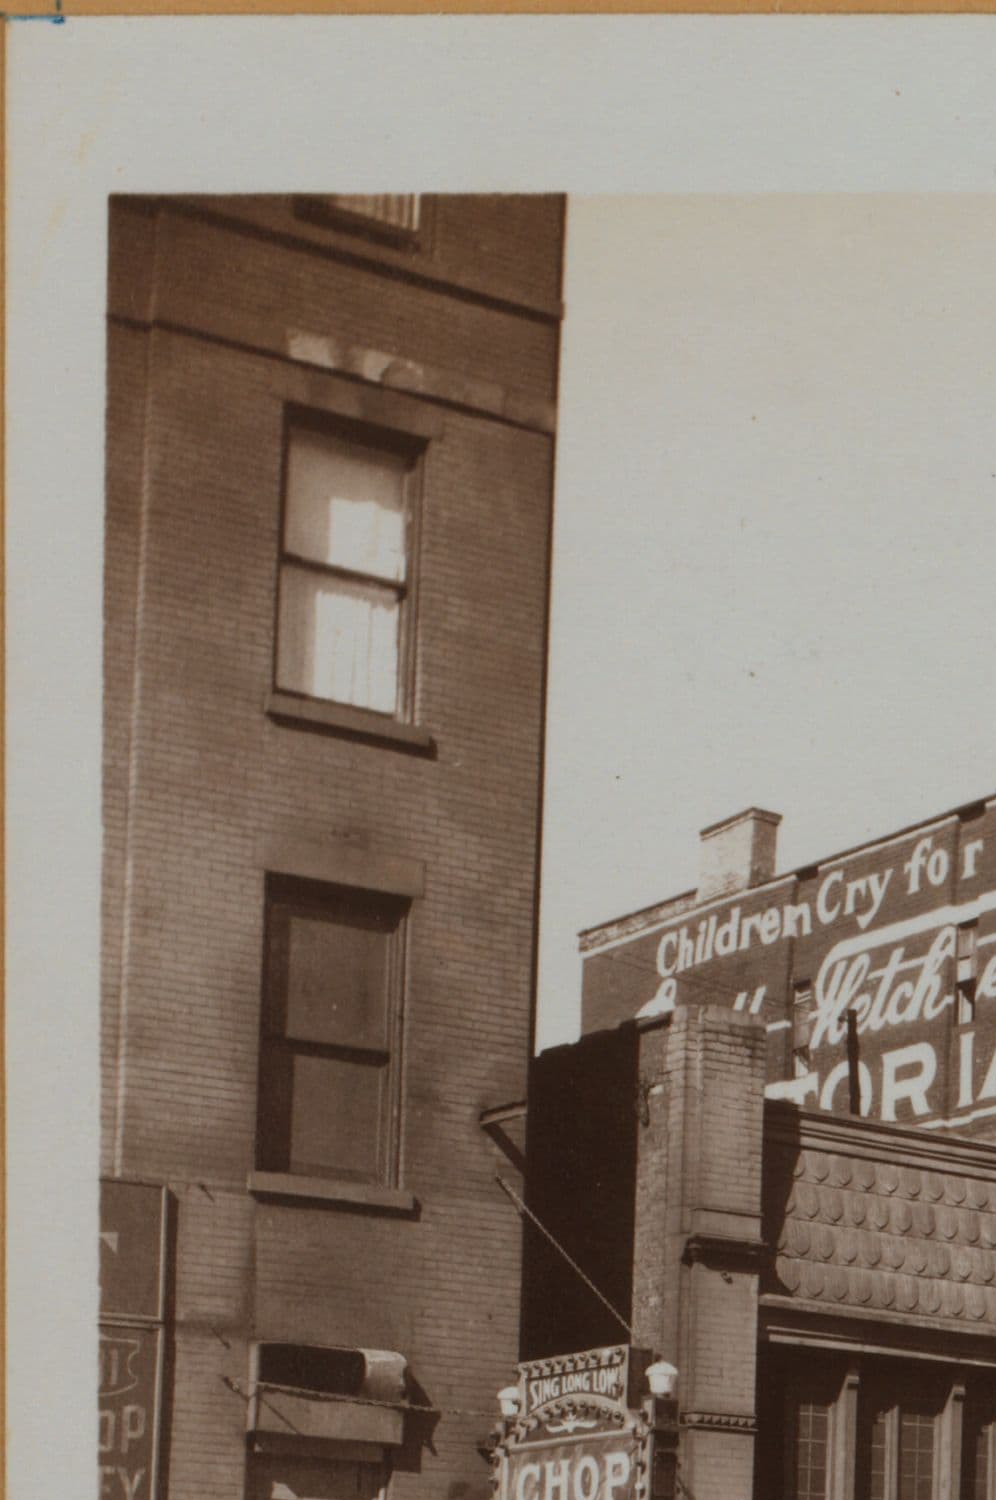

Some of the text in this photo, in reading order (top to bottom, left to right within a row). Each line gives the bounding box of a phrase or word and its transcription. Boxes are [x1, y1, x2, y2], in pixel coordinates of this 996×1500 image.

[656, 836, 985, 979] Children Cry for
[529, 1377, 560, 1410] SING
